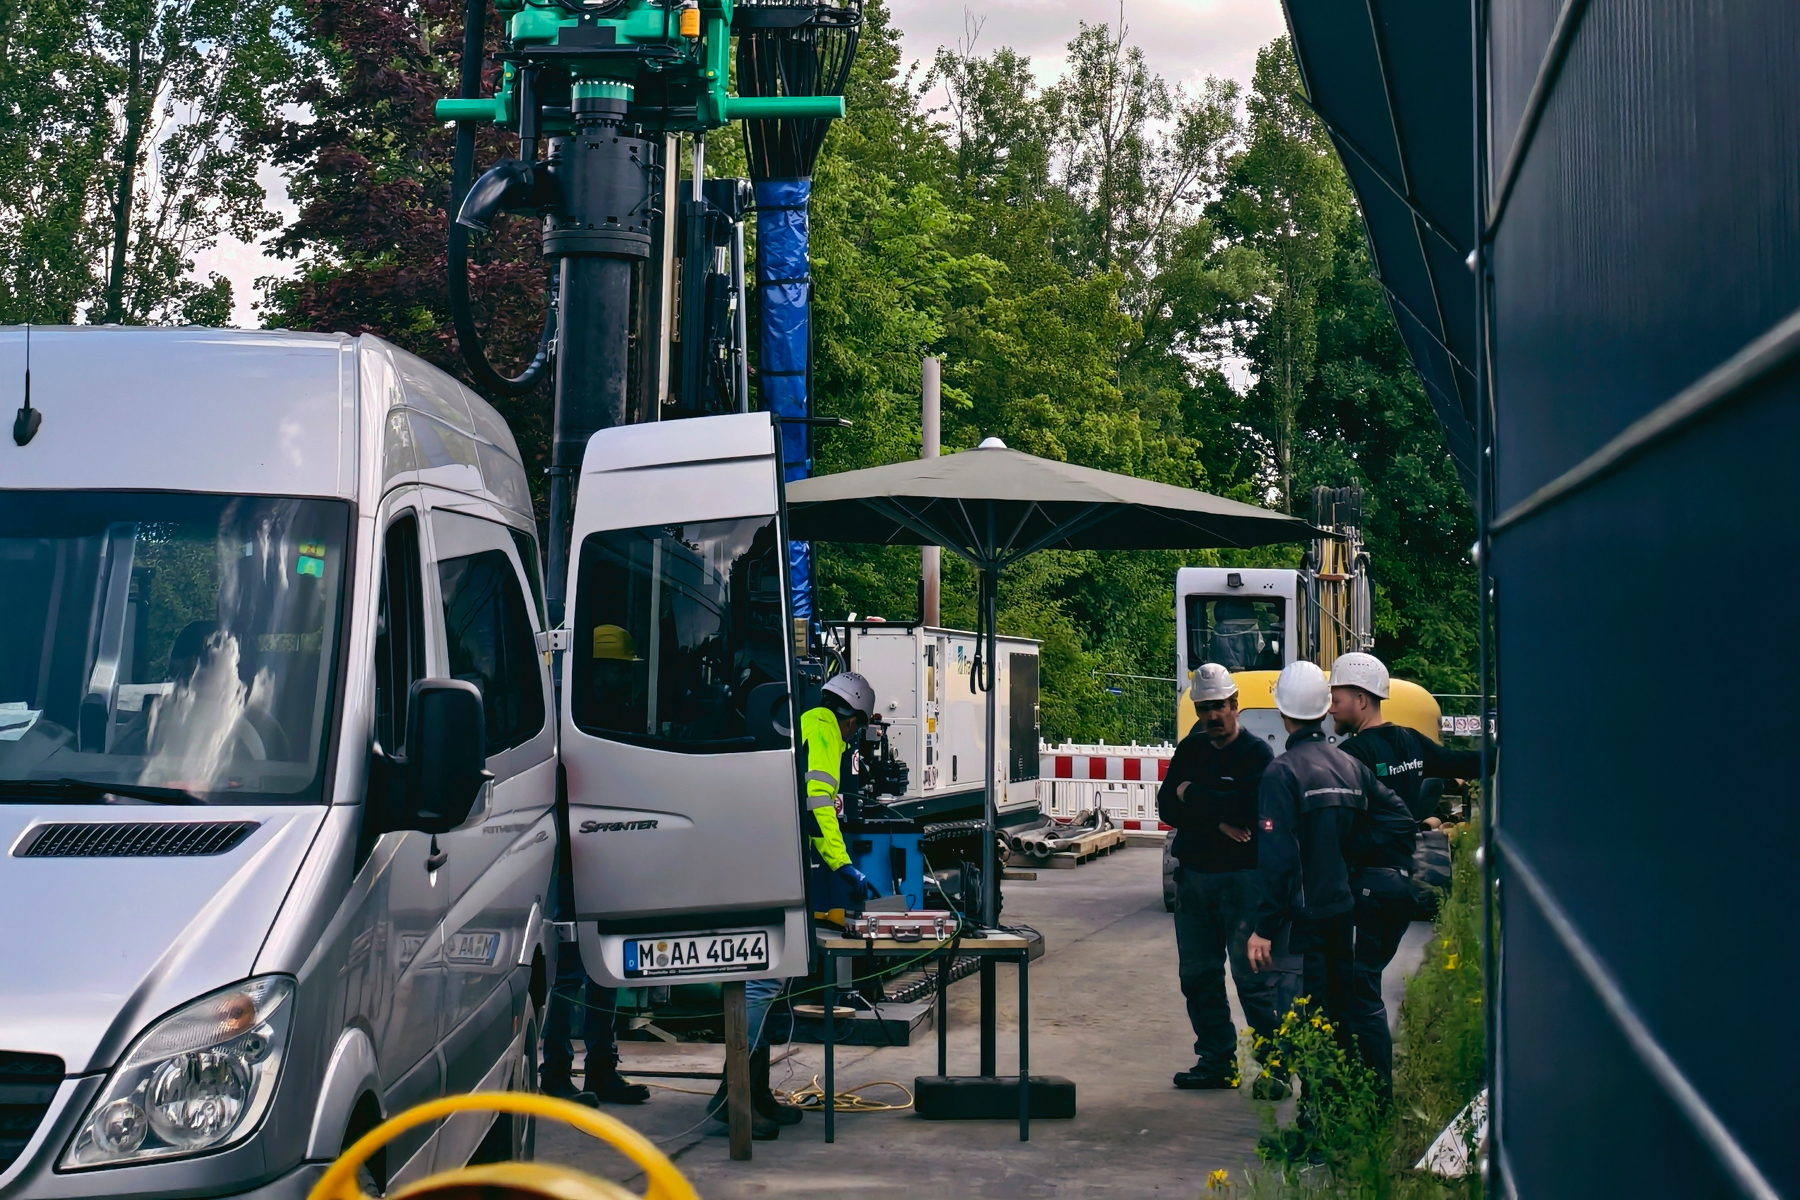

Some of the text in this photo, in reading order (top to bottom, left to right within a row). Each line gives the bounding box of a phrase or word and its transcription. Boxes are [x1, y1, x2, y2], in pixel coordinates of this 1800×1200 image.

[628, 936, 764, 967] D M AA 4044
